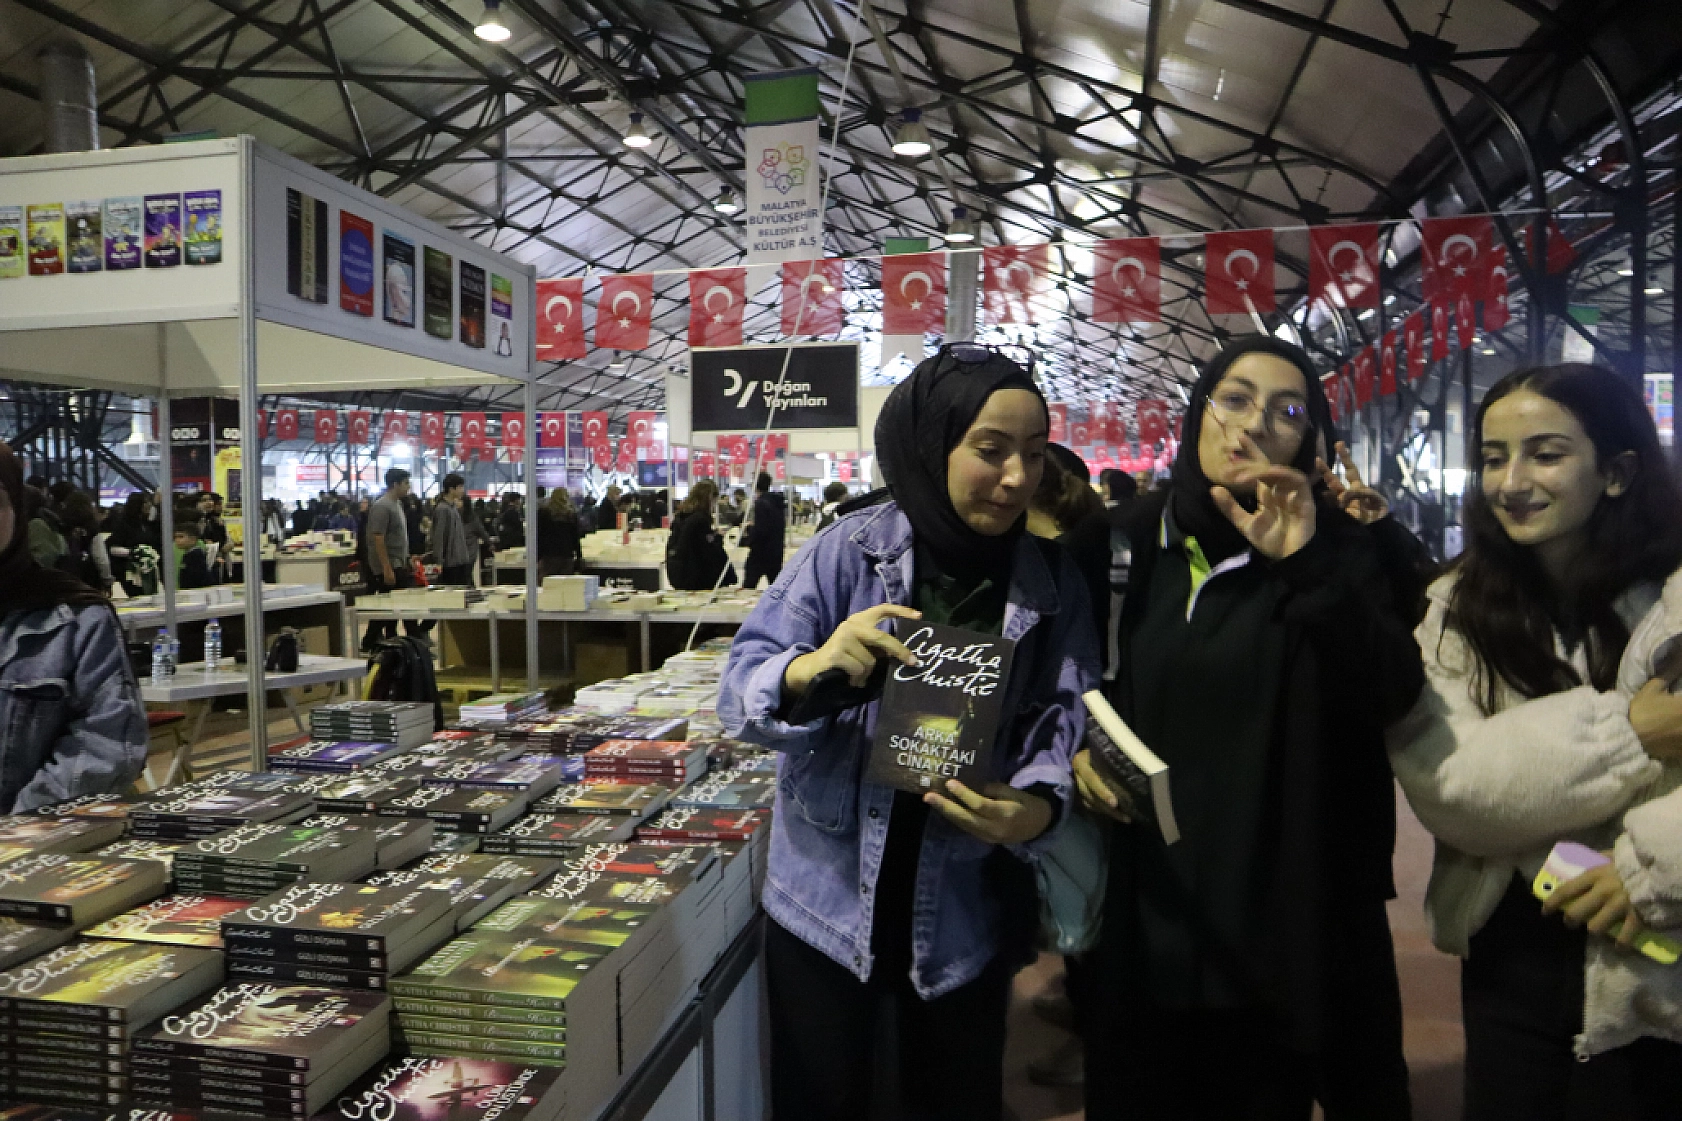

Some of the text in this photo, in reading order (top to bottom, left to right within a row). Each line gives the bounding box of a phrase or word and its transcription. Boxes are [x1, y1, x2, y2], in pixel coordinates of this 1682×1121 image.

[761, 199, 807, 212] MALATYA
[749, 208, 819, 225] BÜYÜKŞEHİR
[758, 224, 809, 238] BELEDİYESİ
[753, 238, 795, 252] KÜLTÜR
[762, 380, 812, 396] Doğan
[893, 658, 1001, 697] Christie
[913, 725, 956, 746] ARKA
